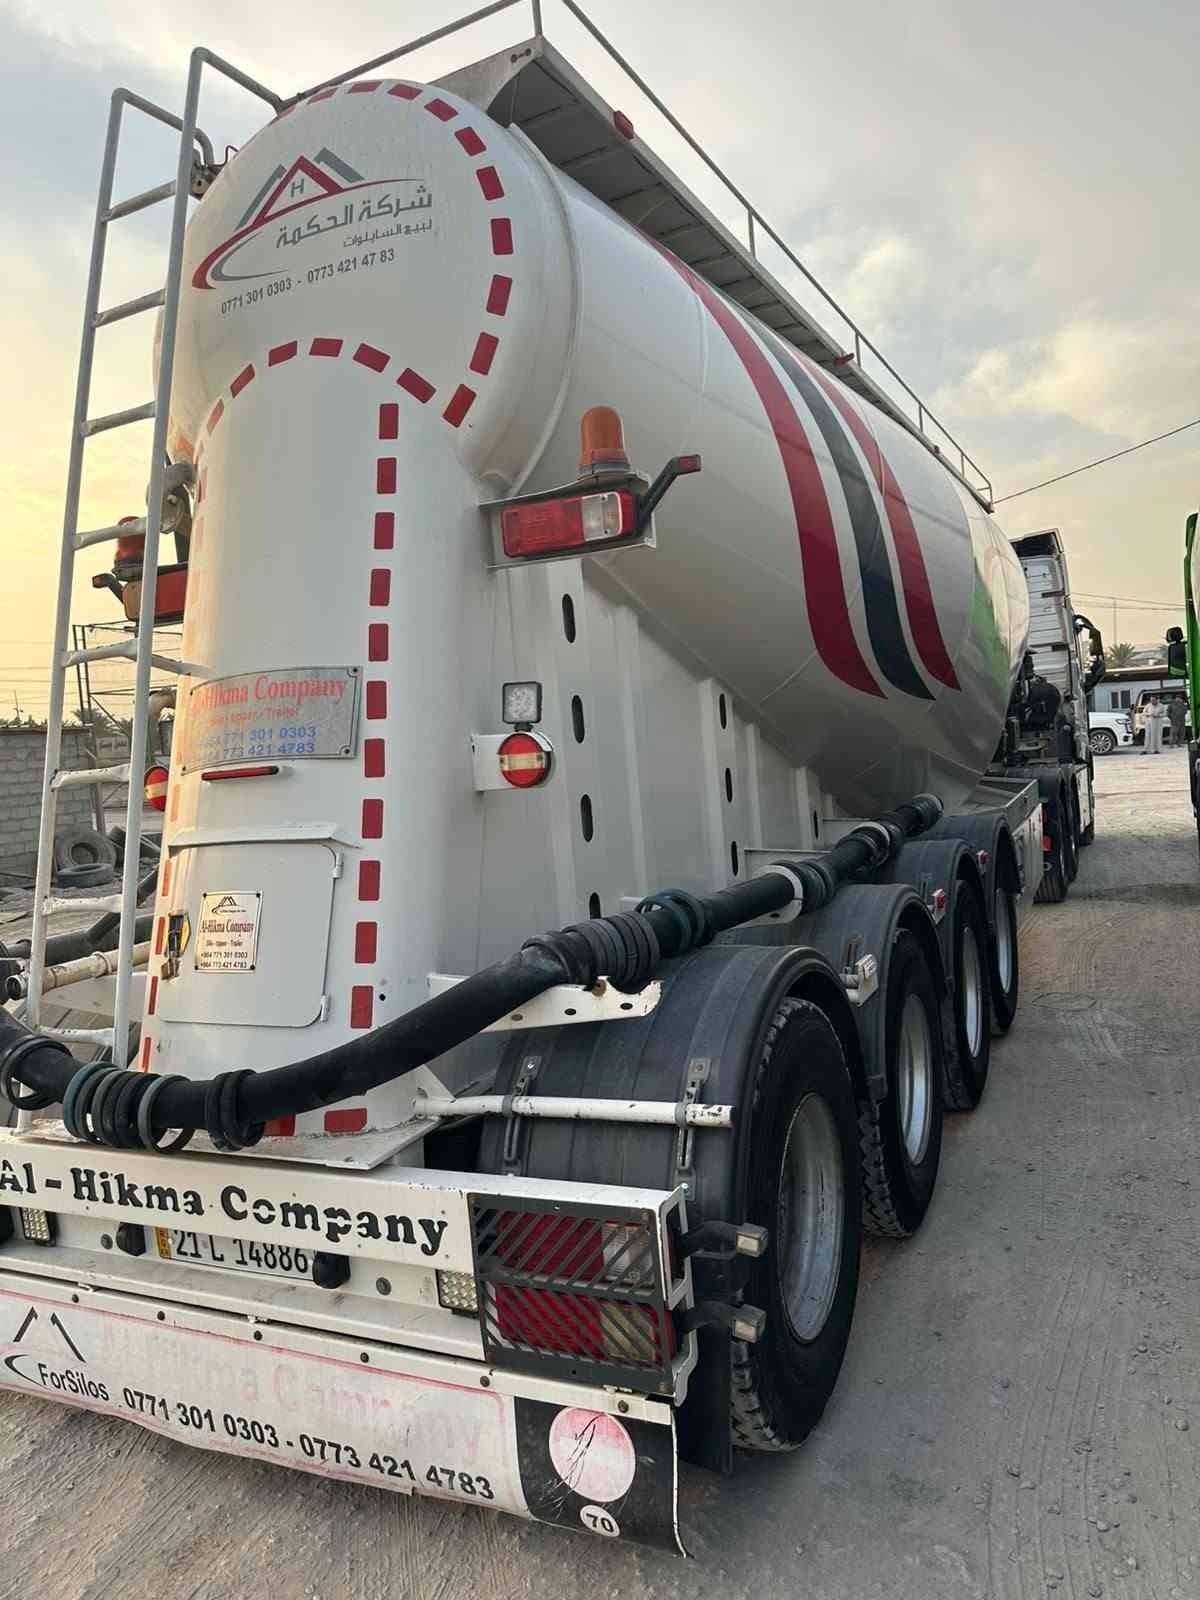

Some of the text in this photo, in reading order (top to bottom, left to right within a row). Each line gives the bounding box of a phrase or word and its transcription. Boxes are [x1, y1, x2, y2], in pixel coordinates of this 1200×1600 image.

[291, 178, 305, 198] H
[275, 185, 432, 249] شركة الحكمة
[221, 294, 243, 314] 0771
[246, 287, 263, 304] 301
[267, 277, 292, 297] 0303
[307, 265, 334, 284] 0773
[337, 256, 358, 273] 421
[361, 252, 376, 267] 47
[380, 248, 395, 263] 83
[253, 673, 347, 705] Company
[279, 726, 317, 738] 0303
[247, 743, 272, 757] 421
[277, 742, 315, 755] 4783
[0, 1159, 37, 1194] Al
[70, 1167, 205, 1216] Hikma
[220, 1184, 449, 1256] Company
[173, 1228, 202, 1259] 21
[38, 1362, 110, 1401] ForSilos
[122, 1387, 170, 1421] 0771
[176, 1402, 216, 1432] 301
[222, 1413, 280, 1448] 0303
[299, 1433, 361, 1468] 0773
[368, 1452, 416, 1481] 421
[425, 1464, 495, 1499] 4783
[585, 1512, 614, 1533] 70
